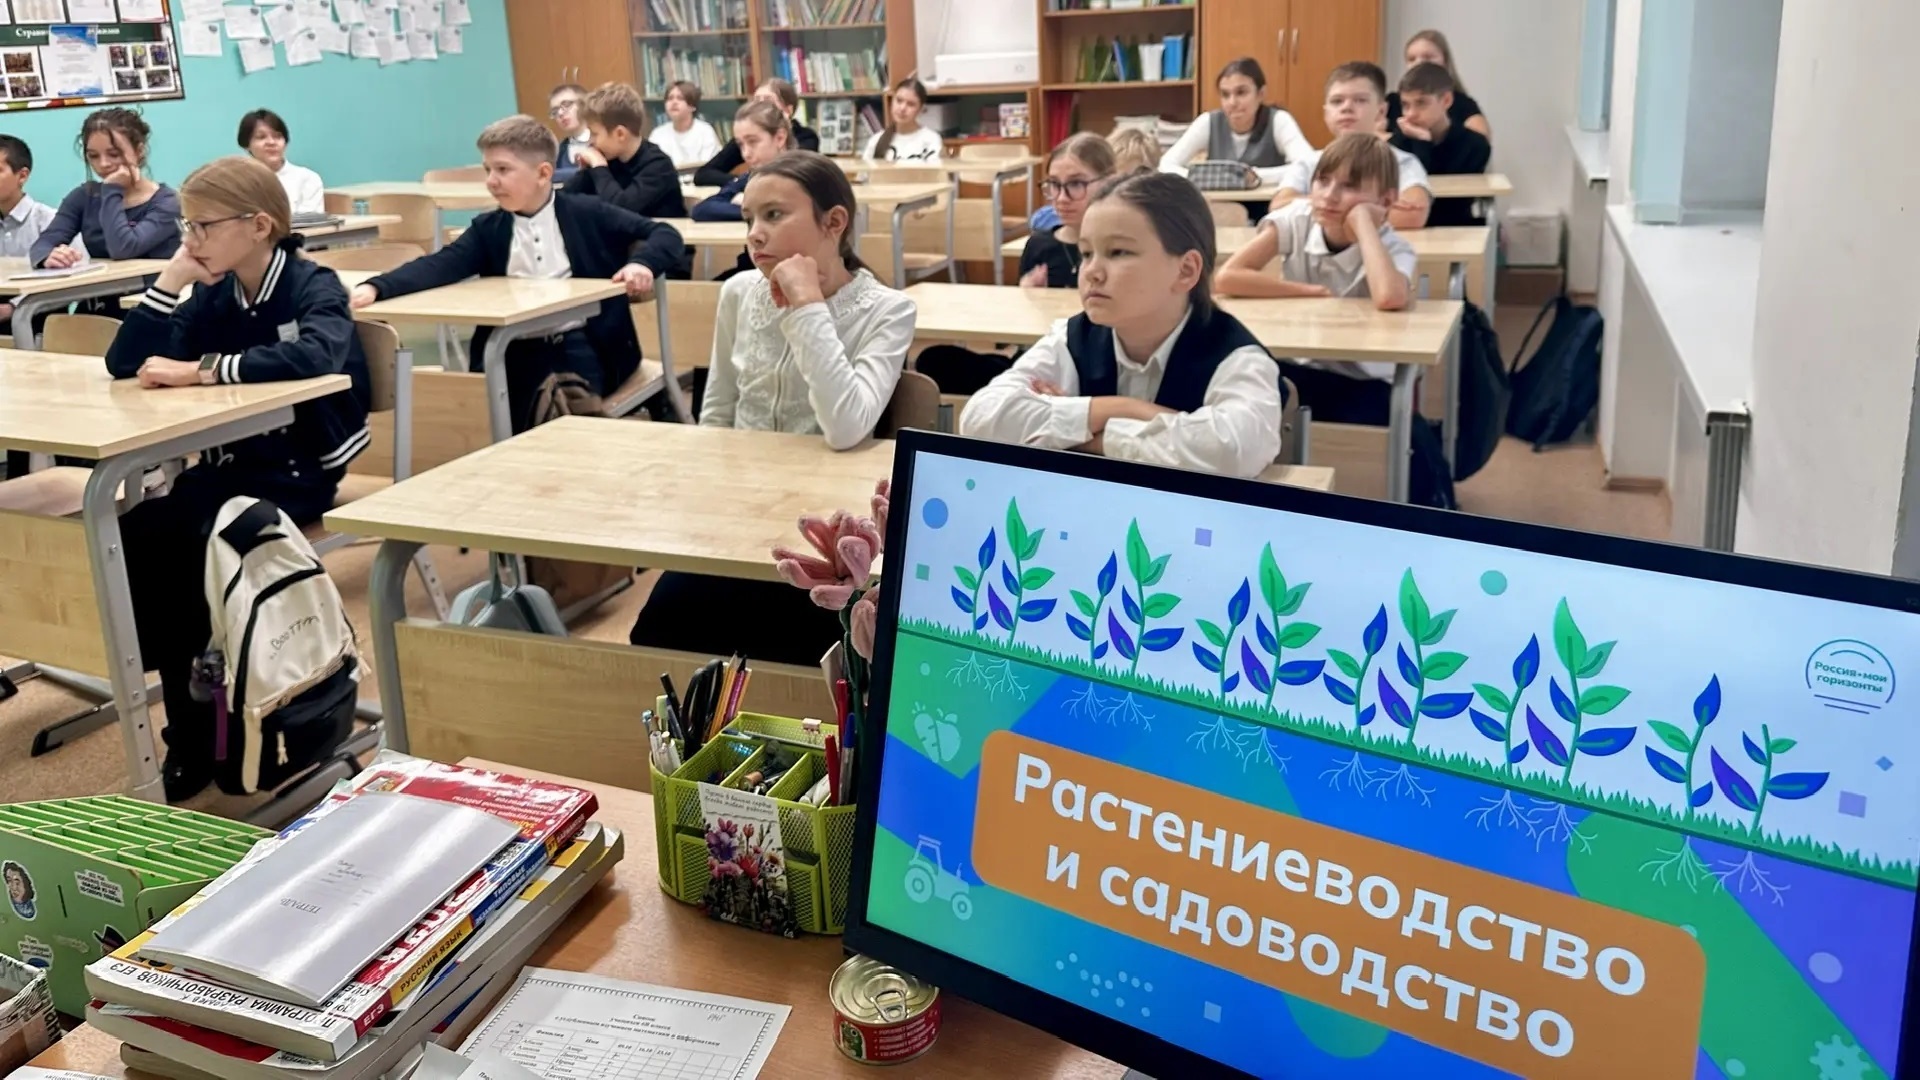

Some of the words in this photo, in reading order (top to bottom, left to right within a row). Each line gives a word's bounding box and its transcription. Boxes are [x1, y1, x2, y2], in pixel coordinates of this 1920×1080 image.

[1816, 674, 1883, 693] горизонты
[493, 865, 525, 897] ТИПОВЫЕ
[1014, 753, 1646, 996] Растениеводство
[280, 898, 322, 914] ТЕТРАДЬ
[400, 951, 438, 992] РУССКИЙ
[440, 931, 463, 953] ЯЗЫК
[1045, 844, 1081, 890] и
[1099, 866, 1575, 1058] садоводство
[110, 962, 135, 976] ЕГЭ
[136, 970, 250, 1006] РАЗРАБОТЧИКОВ
[363, 1003, 385, 1027] ЕГЭ
[536, 1029, 565, 1038] Фамилия
